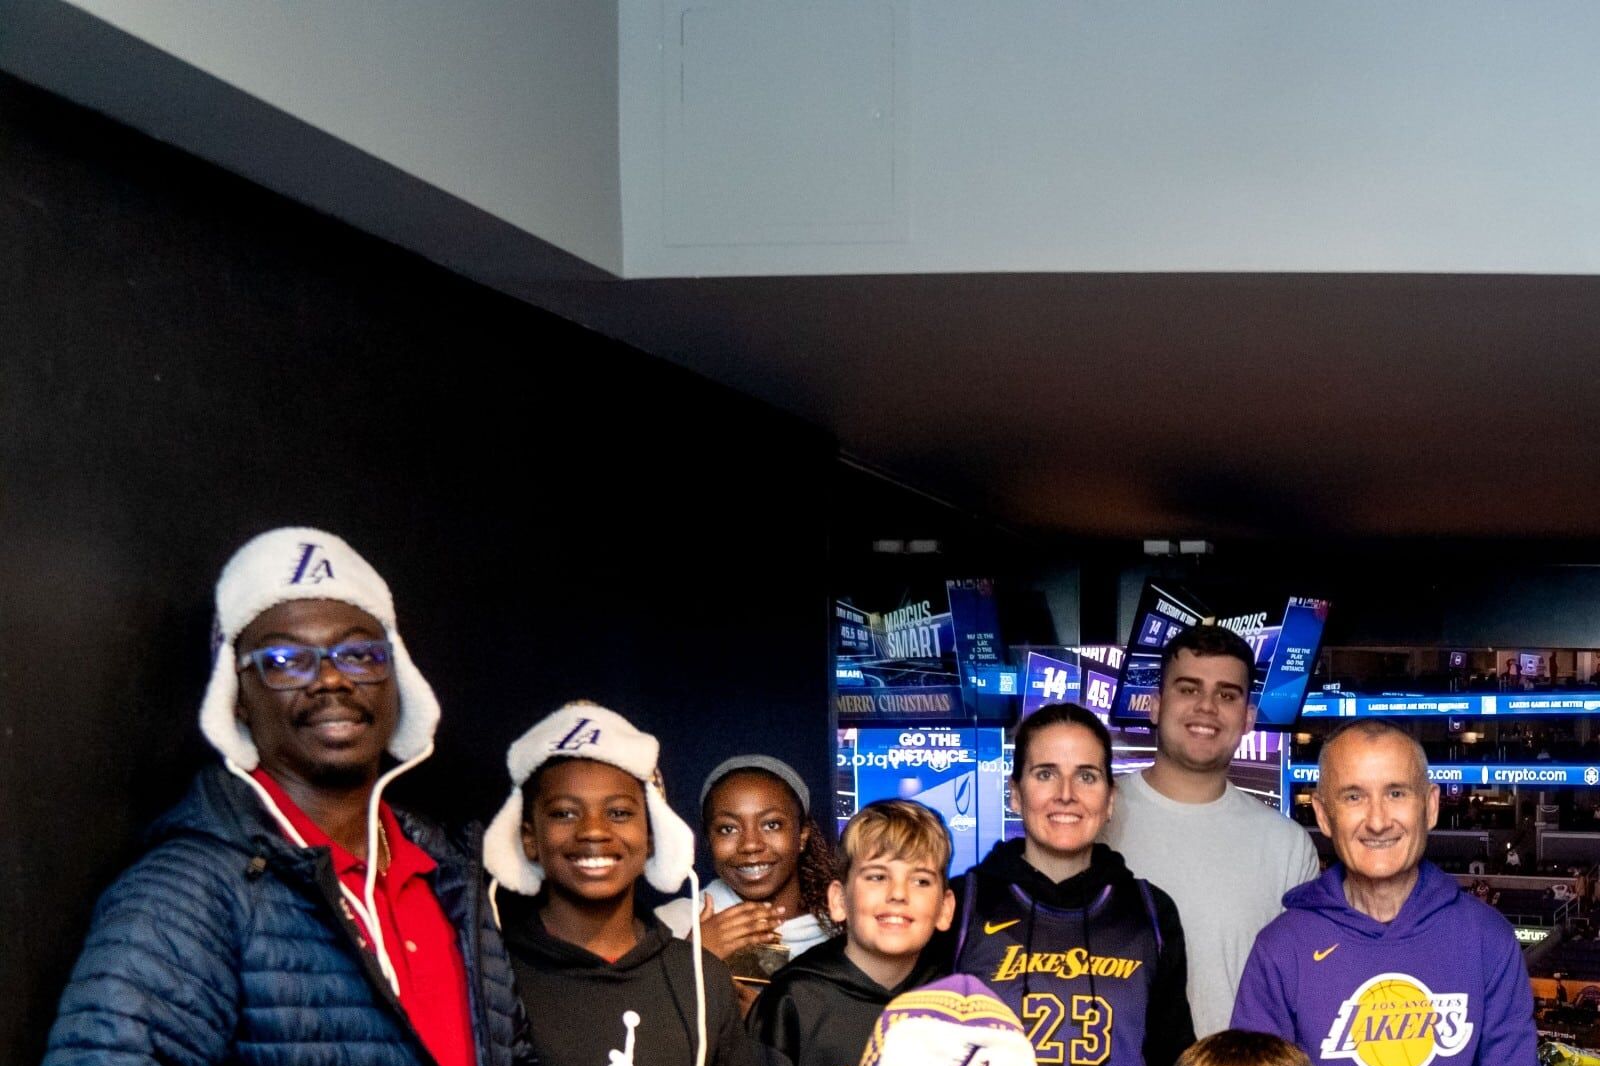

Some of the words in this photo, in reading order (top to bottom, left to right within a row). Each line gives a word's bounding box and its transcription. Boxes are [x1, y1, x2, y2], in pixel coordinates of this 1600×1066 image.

[884, 600, 932, 632] MARCUS
[1148, 620, 1162, 635] 14
[887, 623, 942, 658] SMART
[1043, 667, 1068, 700] 14
[1088, 679, 1117, 709] 45.
[878, 694, 950, 712] CHRISTMAS
[899, 733, 926, 747] GO
[928, 733, 961, 747] THE
[1494, 769, 1567, 783] crypto.com
[1372, 1002, 1396, 1011] LOS
[1403, 999, 1462, 1010] ANGELES
[1022, 993, 1113, 1066] 23
[1328, 1004, 1466, 1053] LAKERS
